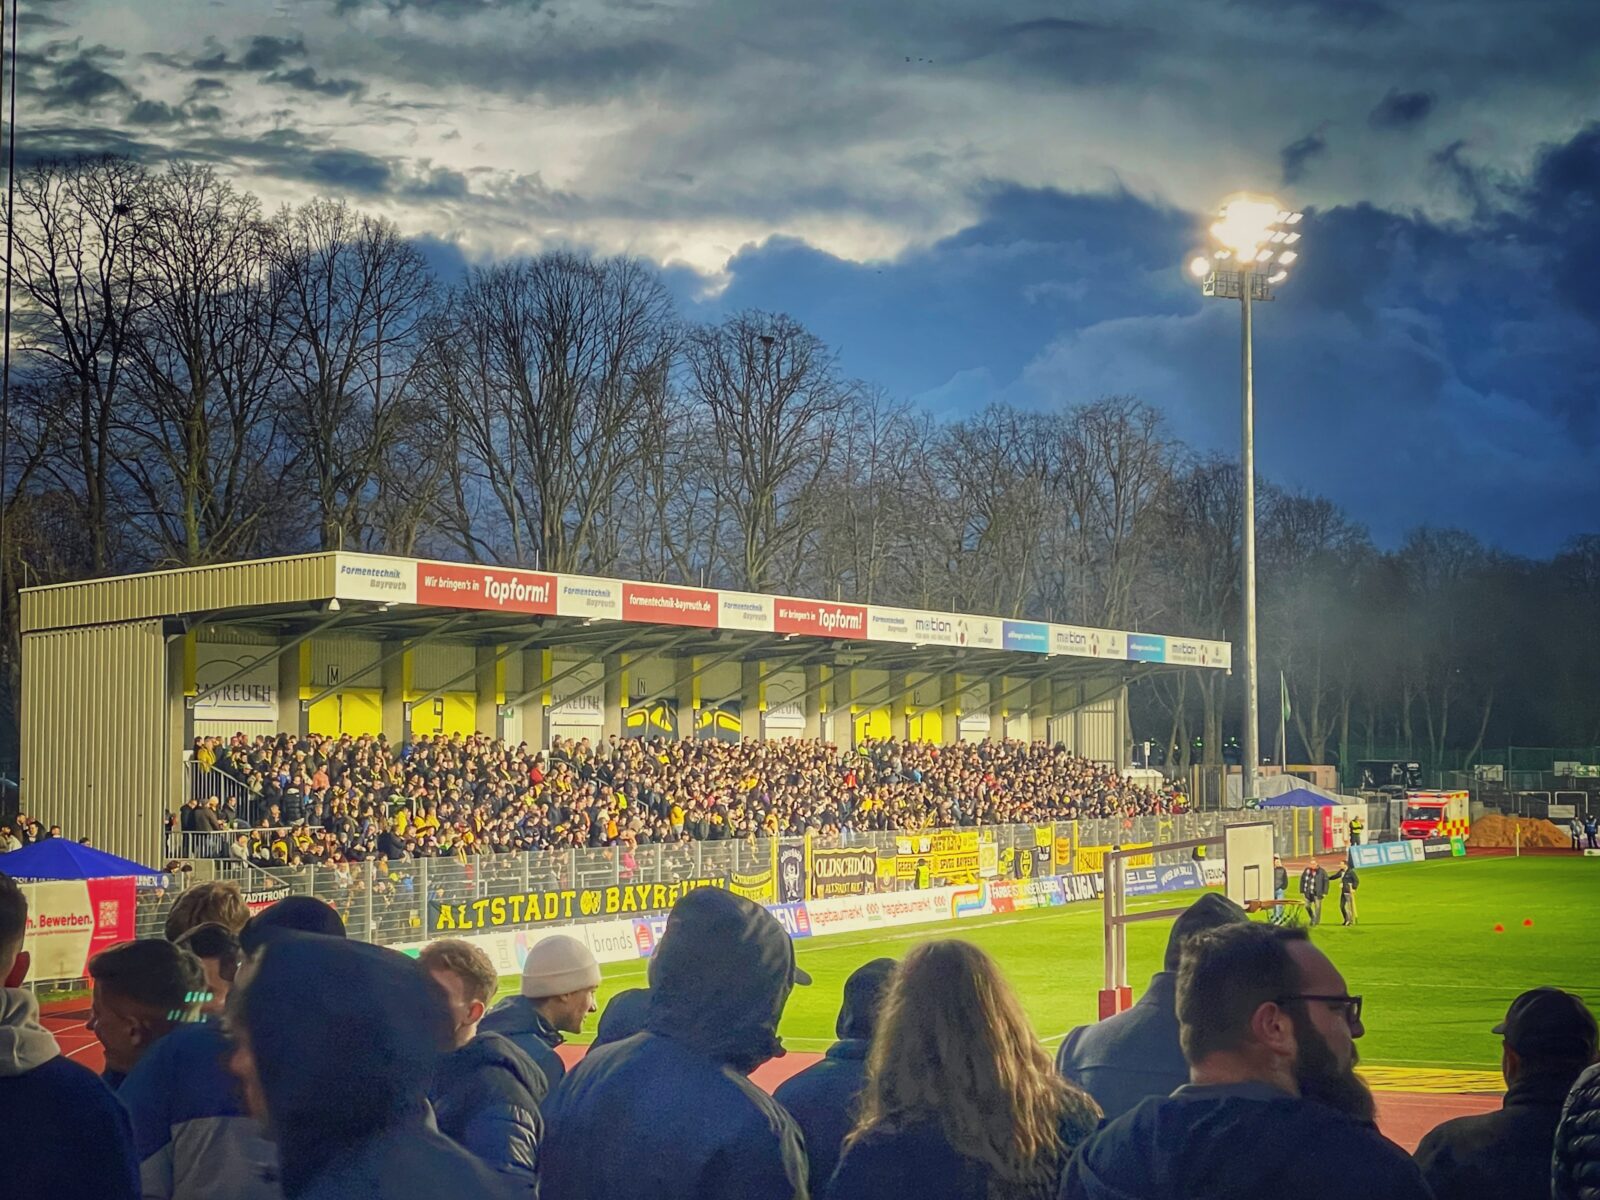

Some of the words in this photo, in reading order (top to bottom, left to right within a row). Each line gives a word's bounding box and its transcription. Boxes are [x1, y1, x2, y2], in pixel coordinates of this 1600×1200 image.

[341, 565, 401, 579] Formentechnik
[370, 579, 407, 590] Bayreuth
[424, 576, 437, 586] Wir
[438, 577, 471, 592] bringen's
[472, 580, 480, 591] in
[484, 576, 550, 605] Topform!
[563, 586, 611, 597] Formentechnik
[629, 594, 711, 612] formentechnik-bayreuth.de
[779, 609, 789, 618] Wir
[818, 608, 863, 632] Topform!
[330, 667, 340, 683] M
[240, 887, 291, 903] TADTFRONT
[436, 890, 576, 930] ALTSTADT
[39, 913, 93, 929] Bewerben.
[593, 930, 633, 953] brands
